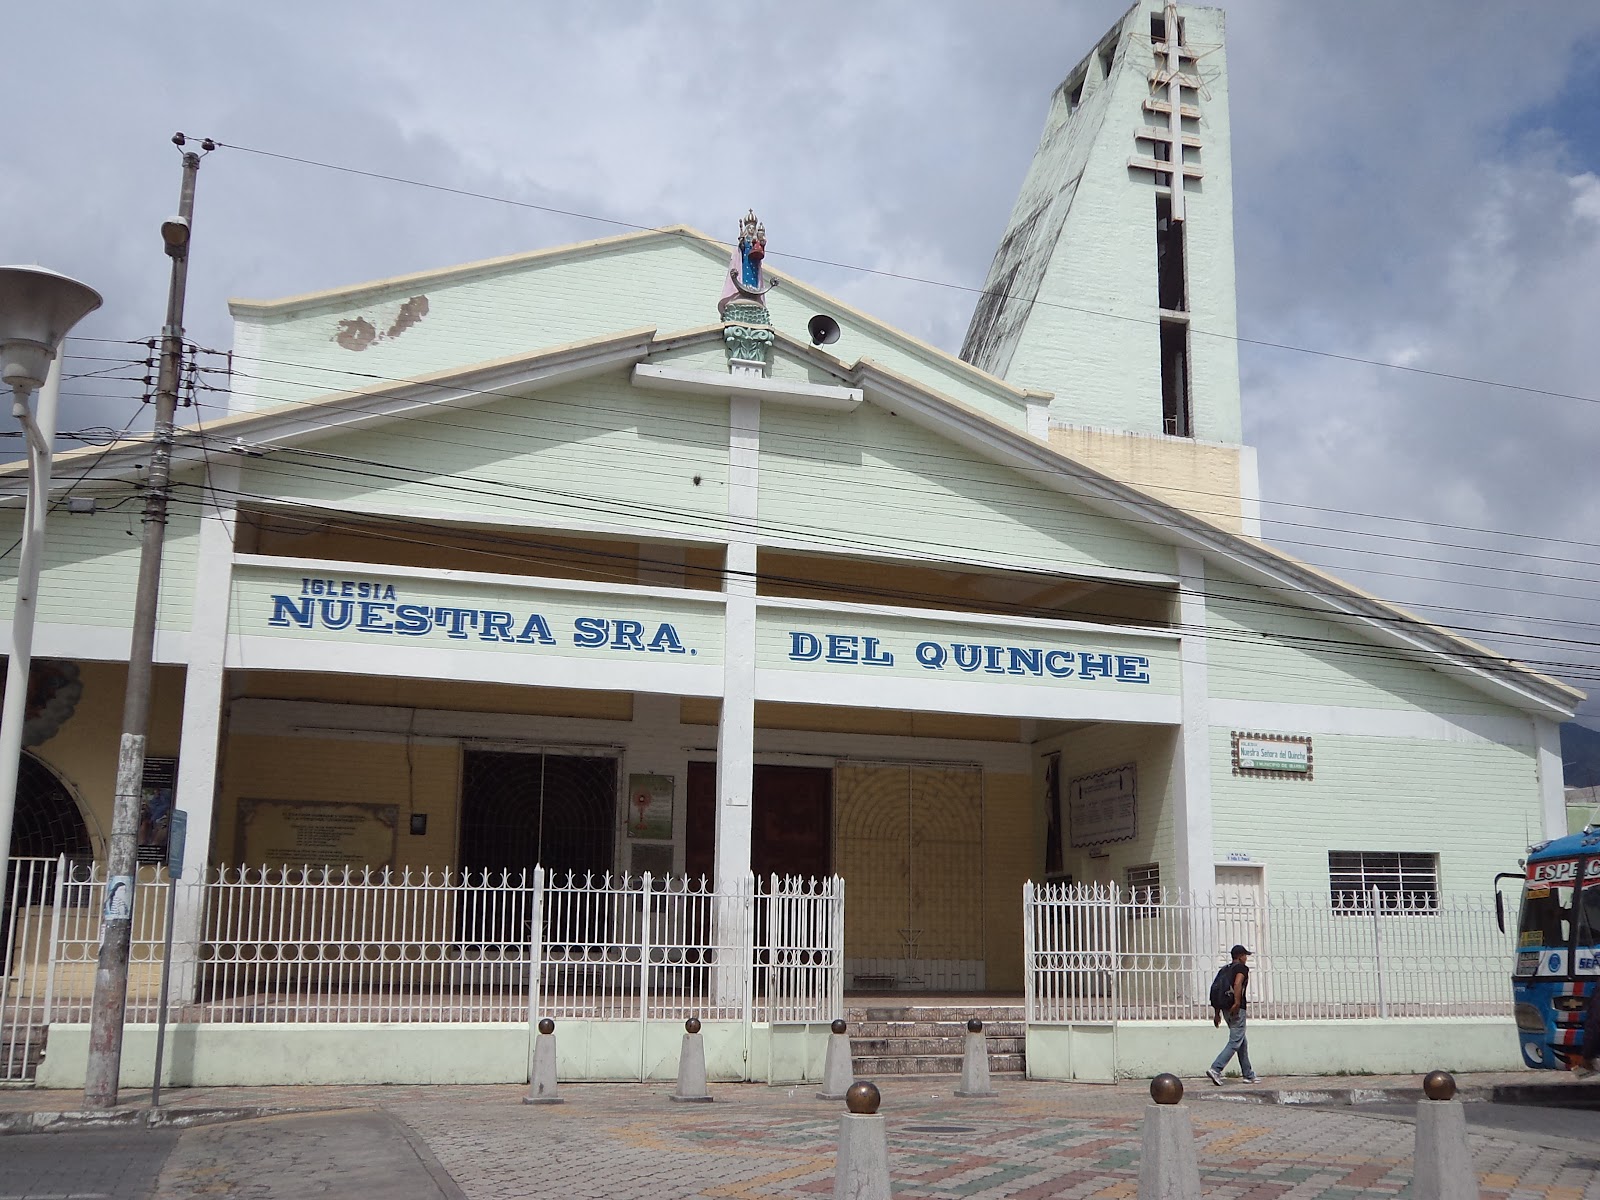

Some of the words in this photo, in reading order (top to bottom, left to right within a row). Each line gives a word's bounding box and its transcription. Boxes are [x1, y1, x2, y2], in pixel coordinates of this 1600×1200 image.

[301, 578, 397, 600] IGLESIA
[268, 594, 557, 646] NUESTRA
[573, 617, 698, 657] SRA.
[788, 631, 895, 667] DEL
[915, 641, 1150, 684] QUINCHE
[1241, 747, 1259, 756] Nuestra
[1261, 749, 1278, 758] Señora
[1287, 751, 1306, 760] Quinche
[1535, 860, 1600, 881] ESPEC
